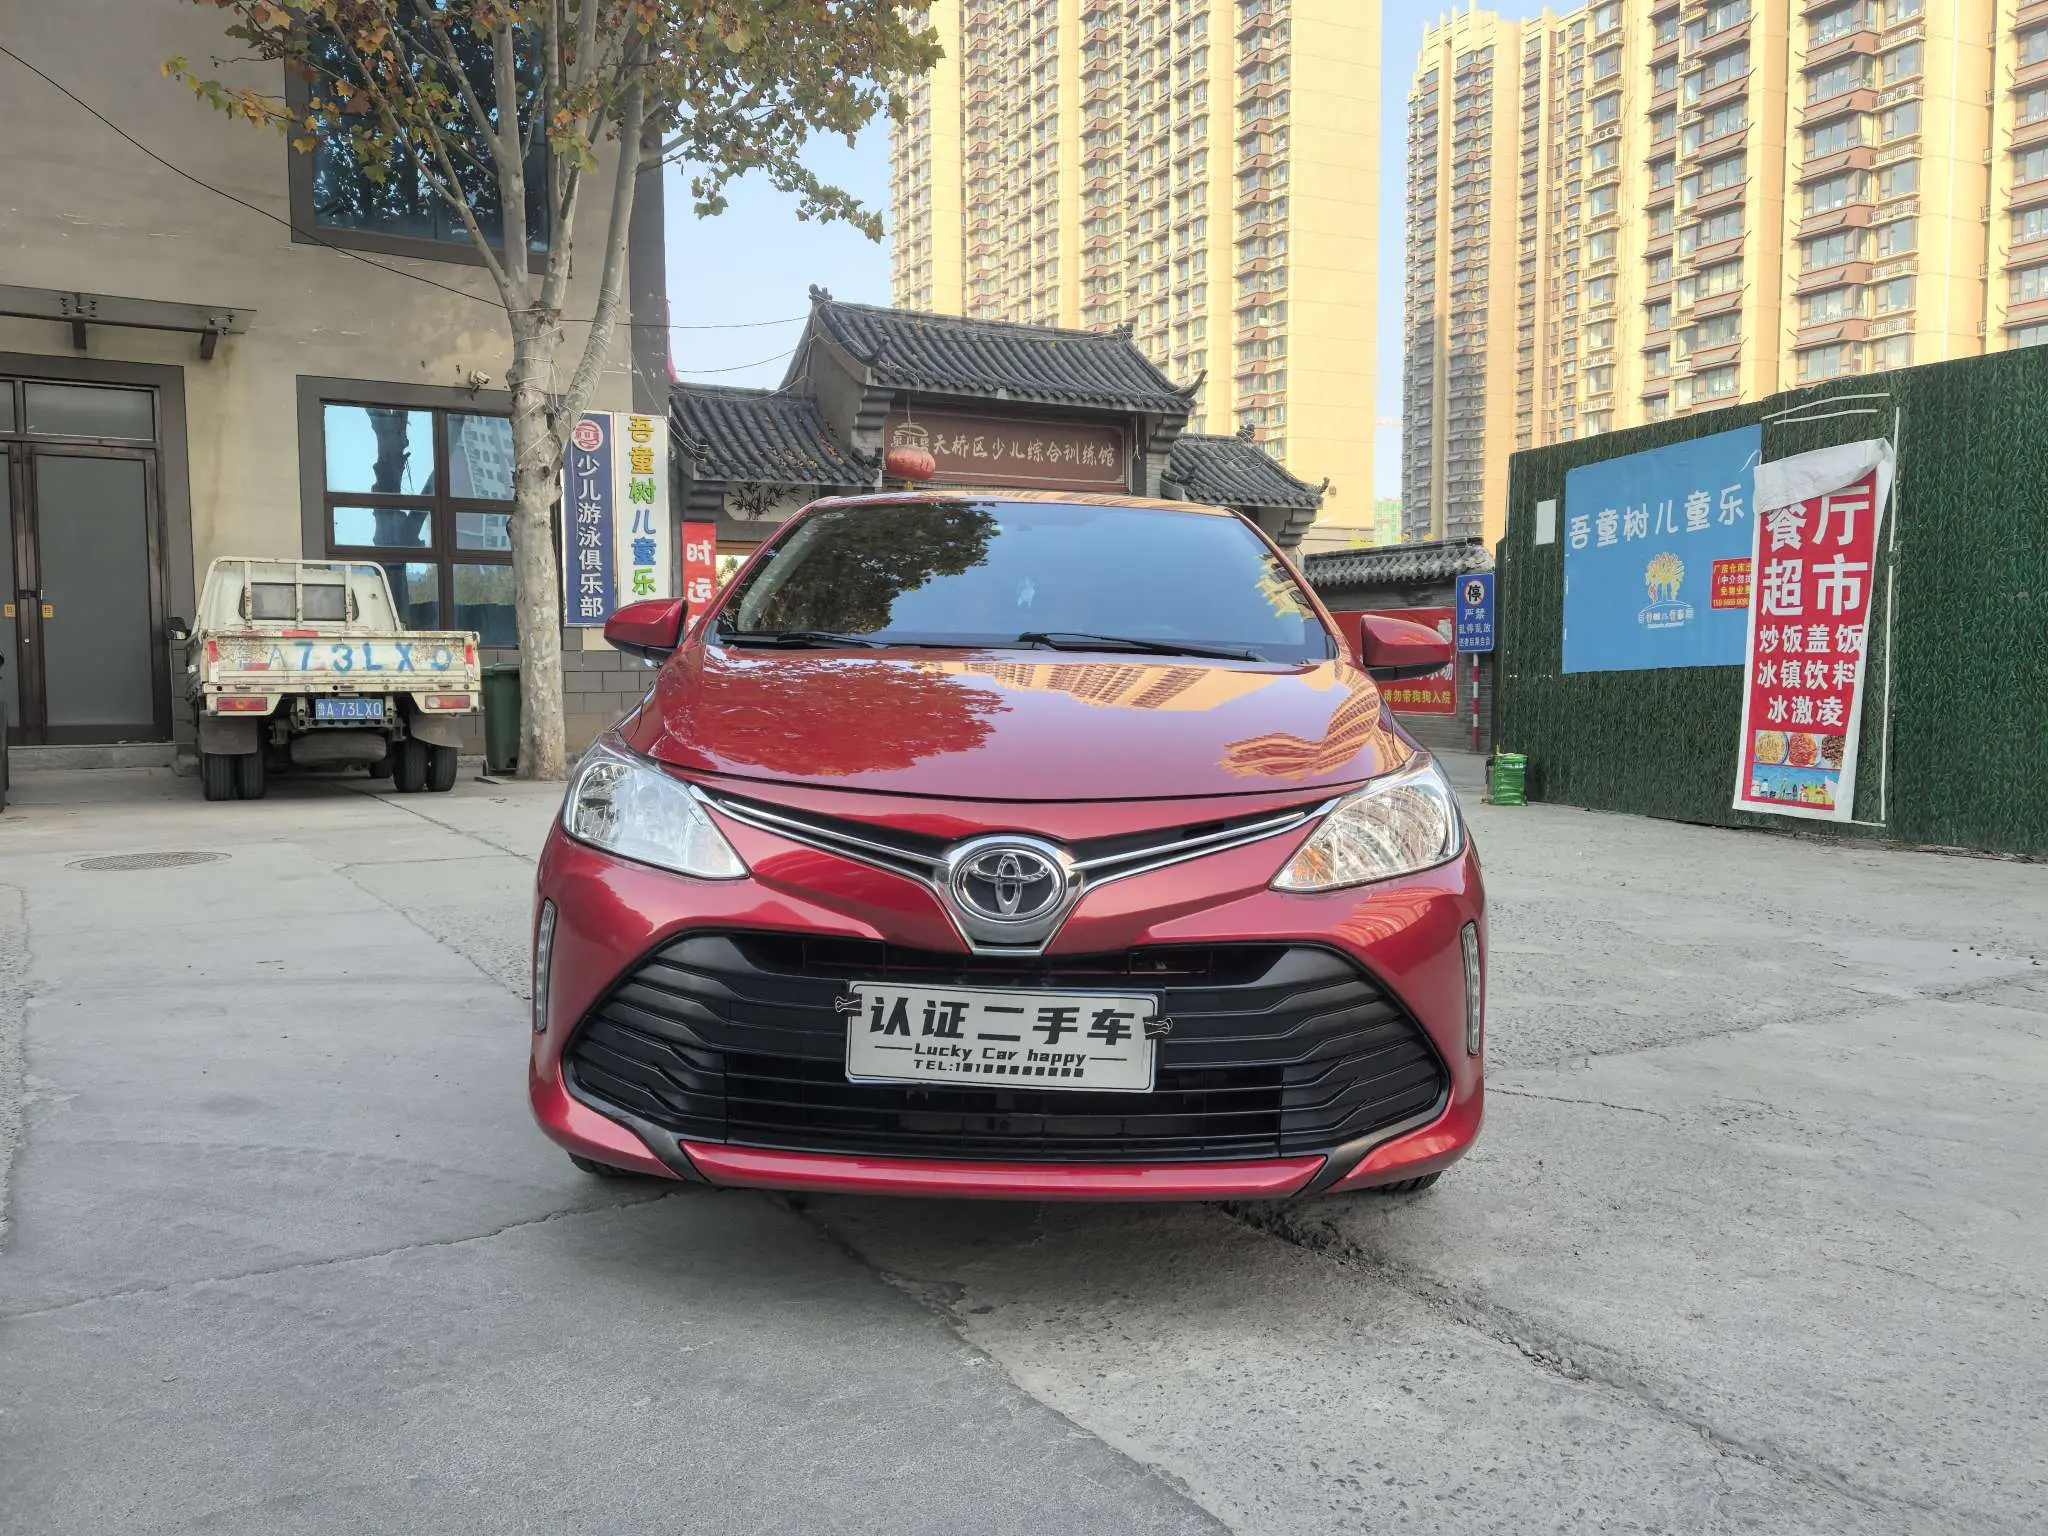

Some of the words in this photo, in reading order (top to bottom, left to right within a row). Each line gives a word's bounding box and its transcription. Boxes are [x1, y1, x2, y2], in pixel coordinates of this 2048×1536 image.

[933, 433, 1115, 468] 天桥区少儿综合训练馆
[1569, 483, 1745, 550] 吾童树儿童乐
[1765, 484, 1870, 552] 餐厅
[577, 455, 604, 617] 少儿游泳俱乐部
[1760, 553, 1868, 617] 超市
[1464, 607, 1485, 621] 严禁
[1759, 623, 1864, 654] 炒饭盖饭
[1757, 659, 1857, 690] 冰镇饮料
[1767, 694, 1844, 727] 冰激凌
[869, 996, 1135, 1045] 认证二手车
[914, 1043, 973, 1062] Lucky
[982, 1047, 1018, 1060] Car
[1027, 1049, 1087, 1067] happy
